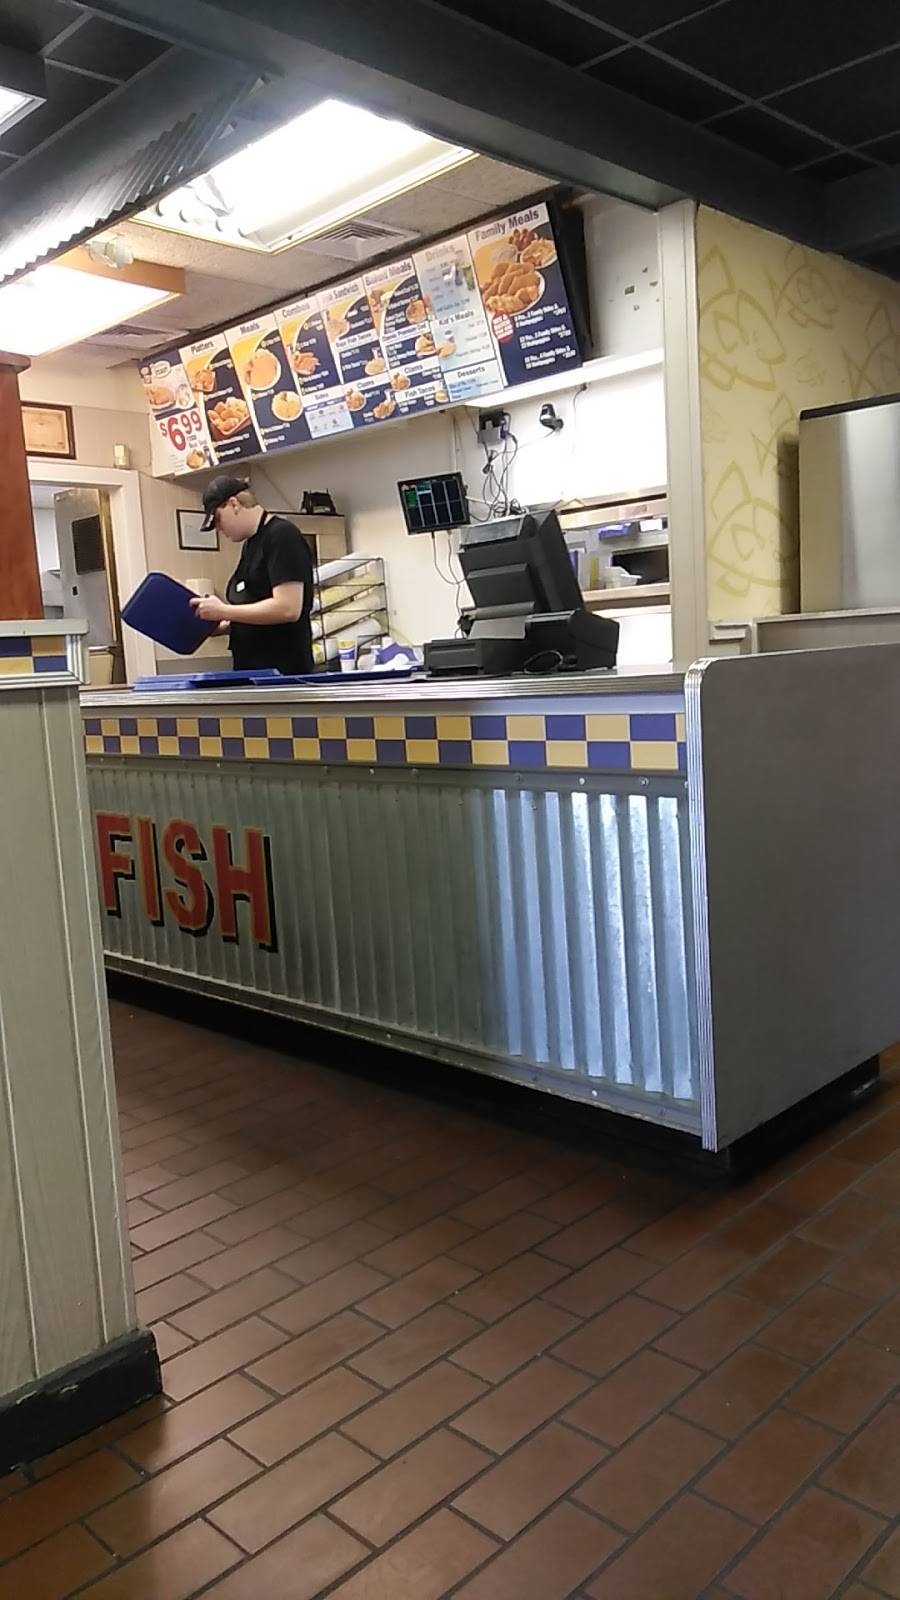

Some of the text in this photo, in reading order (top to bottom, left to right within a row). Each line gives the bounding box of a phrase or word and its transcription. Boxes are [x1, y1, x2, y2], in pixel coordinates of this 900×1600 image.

[475, 208, 540, 241] Family Meals
[457, 366, 486, 378] Desserts
[405, 386, 435, 398] Fish Tacos
[96, 811, 278, 952] FISH
